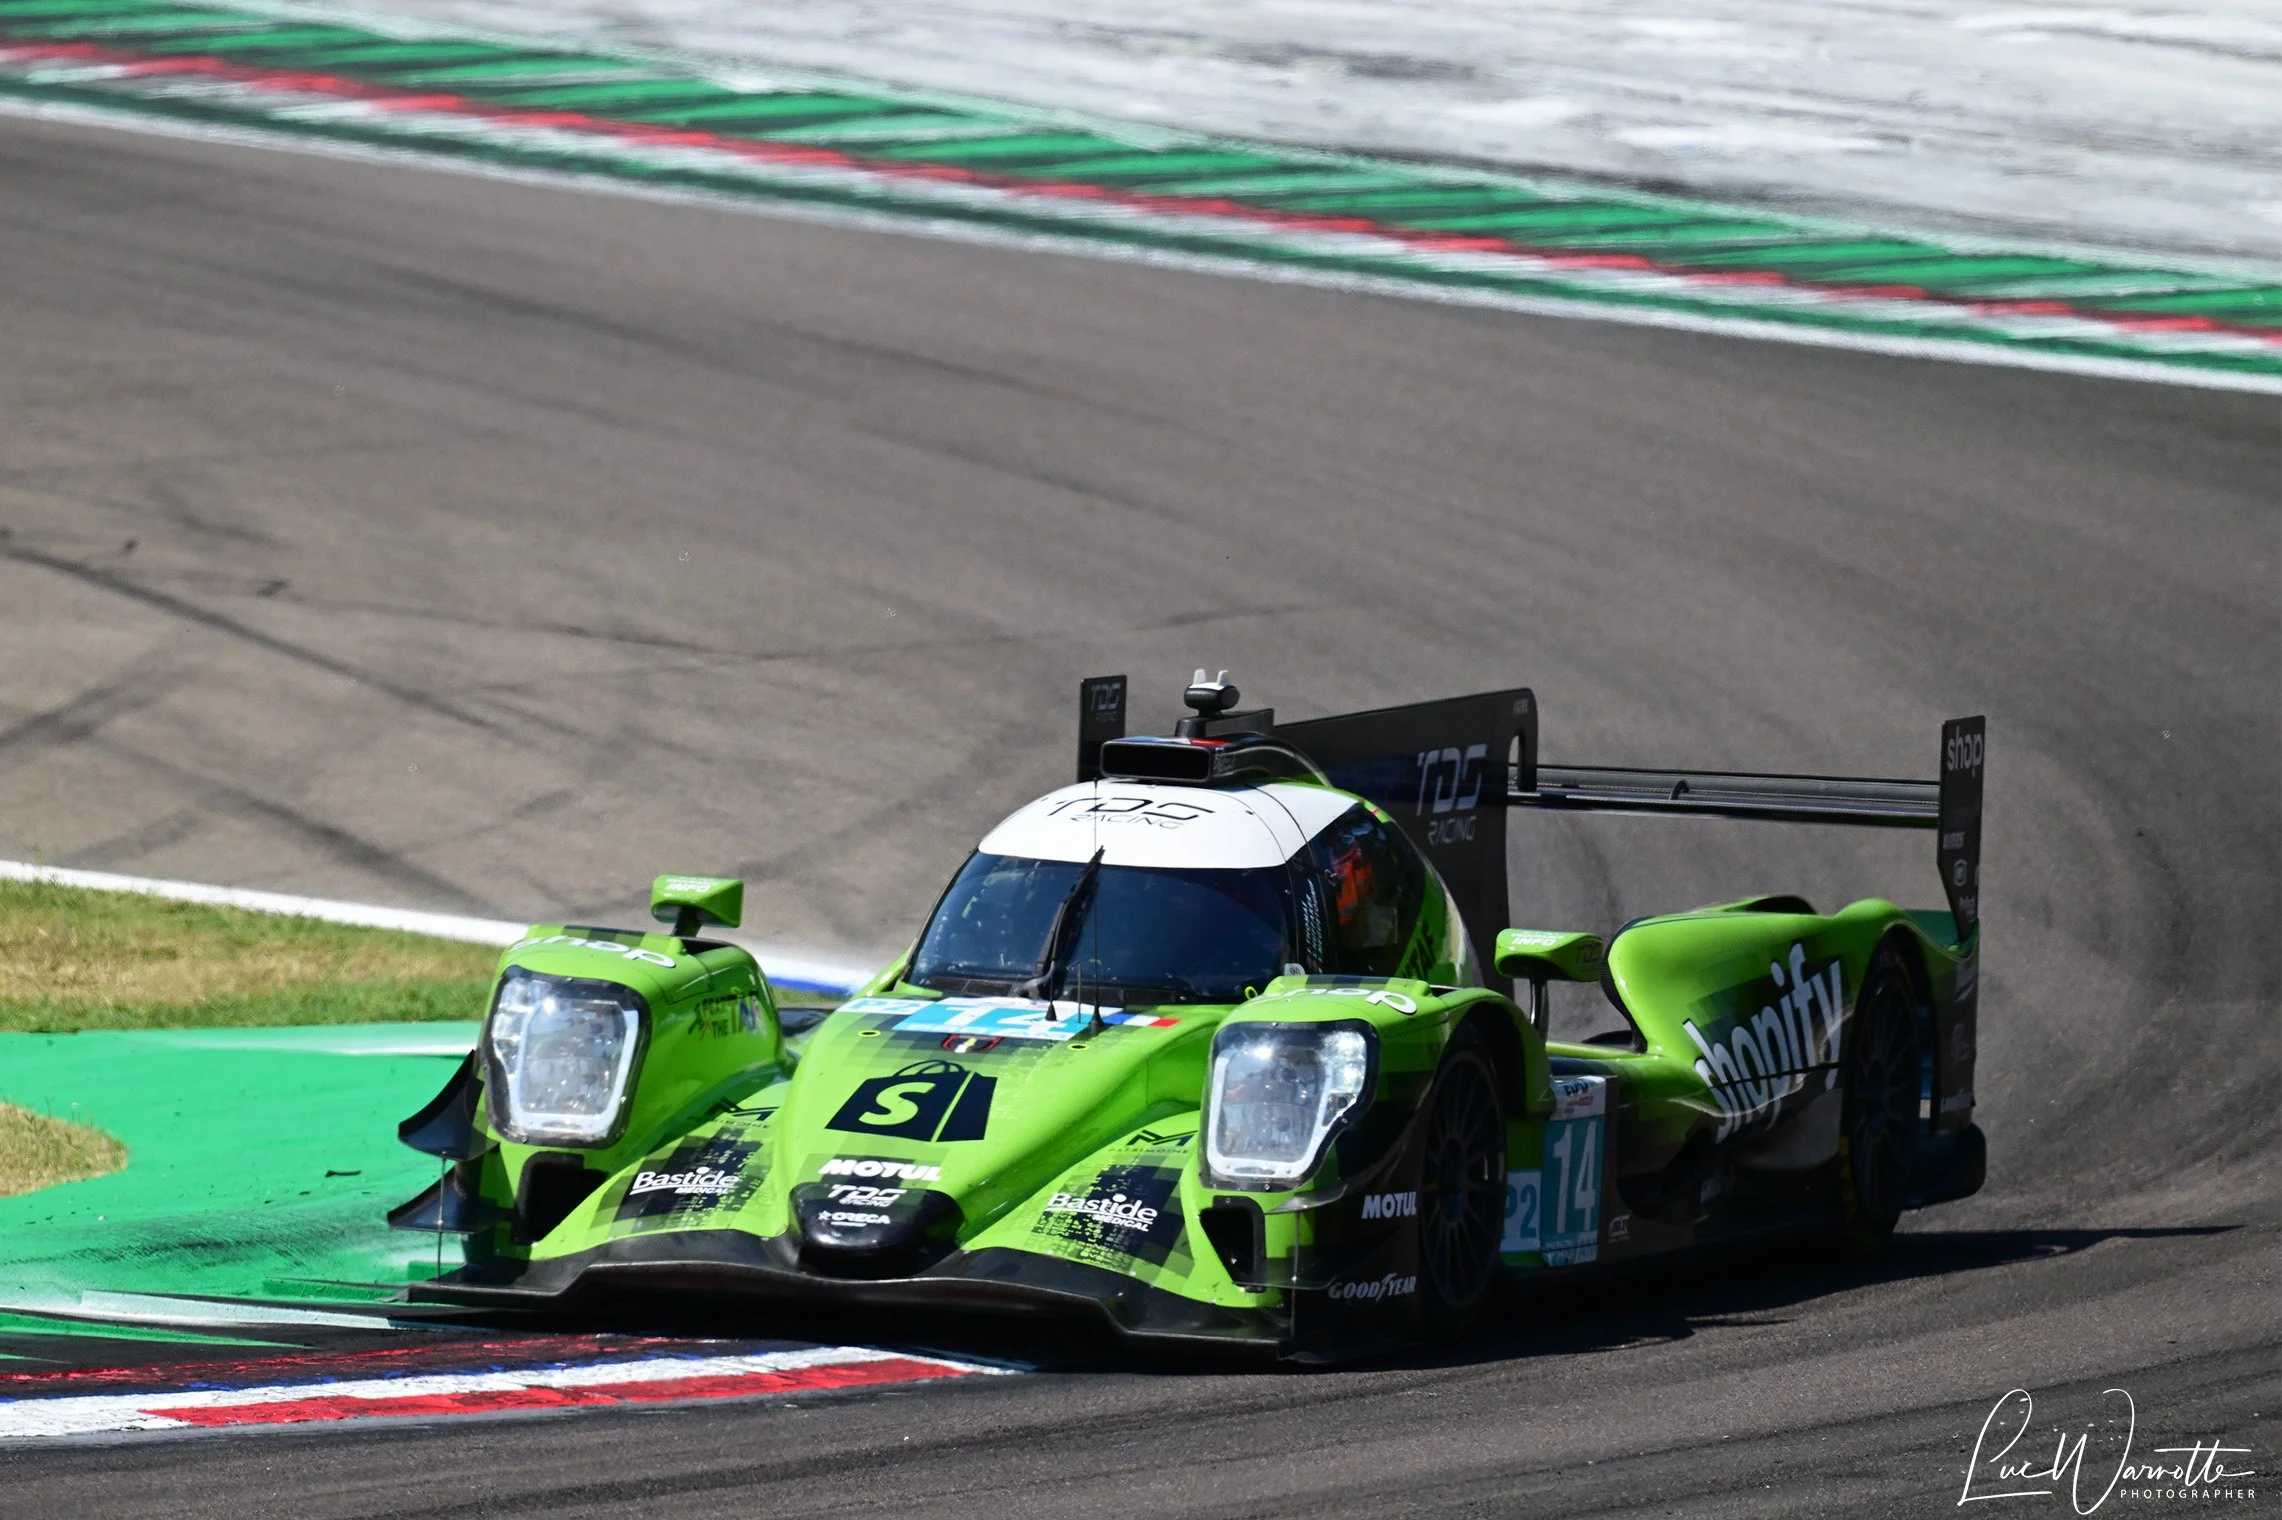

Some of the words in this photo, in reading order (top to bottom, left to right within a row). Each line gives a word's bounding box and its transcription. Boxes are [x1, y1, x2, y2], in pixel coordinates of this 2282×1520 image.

[1947, 726, 1983, 778] shop
[1416, 743, 1487, 816] TDS
[1048, 798, 1215, 820] TDS
[1428, 815, 1477, 847] RACING
[1683, 942, 1843, 1145] shopify
[632, 1166, 740, 1189] Bastide
[818, 1159, 942, 1182] MOTUL
[1553, 1120, 1597, 1234] 14
[828, 1184, 907, 1201] TDS
[1361, 1191, 1417, 1219] MOTUL
[831, 1212, 891, 1225] ORECA
[1047, 1193, 1158, 1222] Bastide
